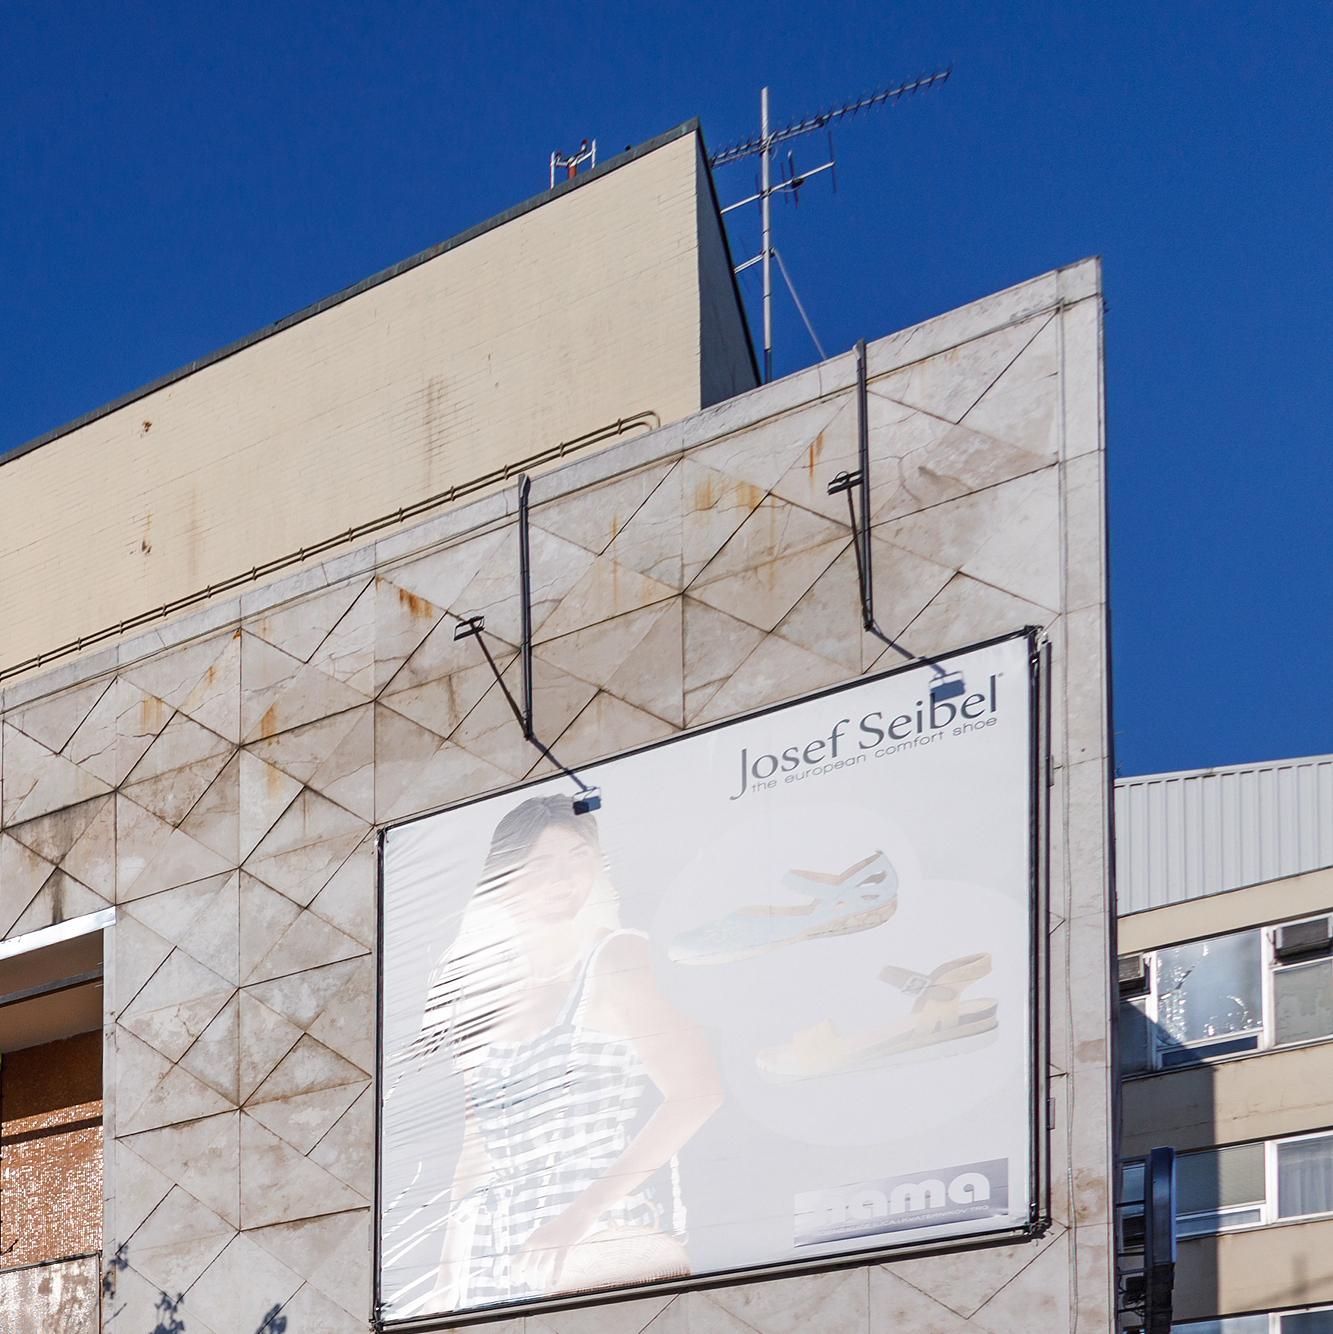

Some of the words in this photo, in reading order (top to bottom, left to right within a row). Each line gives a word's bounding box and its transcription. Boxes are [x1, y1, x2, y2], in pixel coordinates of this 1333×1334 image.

[729, 718, 851, 801] Josef
[858, 674, 998, 750] Seibel
[751, 778, 778, 793] the
[784, 753, 867, 785] european
[874, 730, 945, 759] comfort
[952, 716, 998, 737] shoe
[814, 1172, 991, 1224] nama
[901, 1208, 967, 1223] KVATERNIKOV
[969, 1204, 989, 1213] TRG
